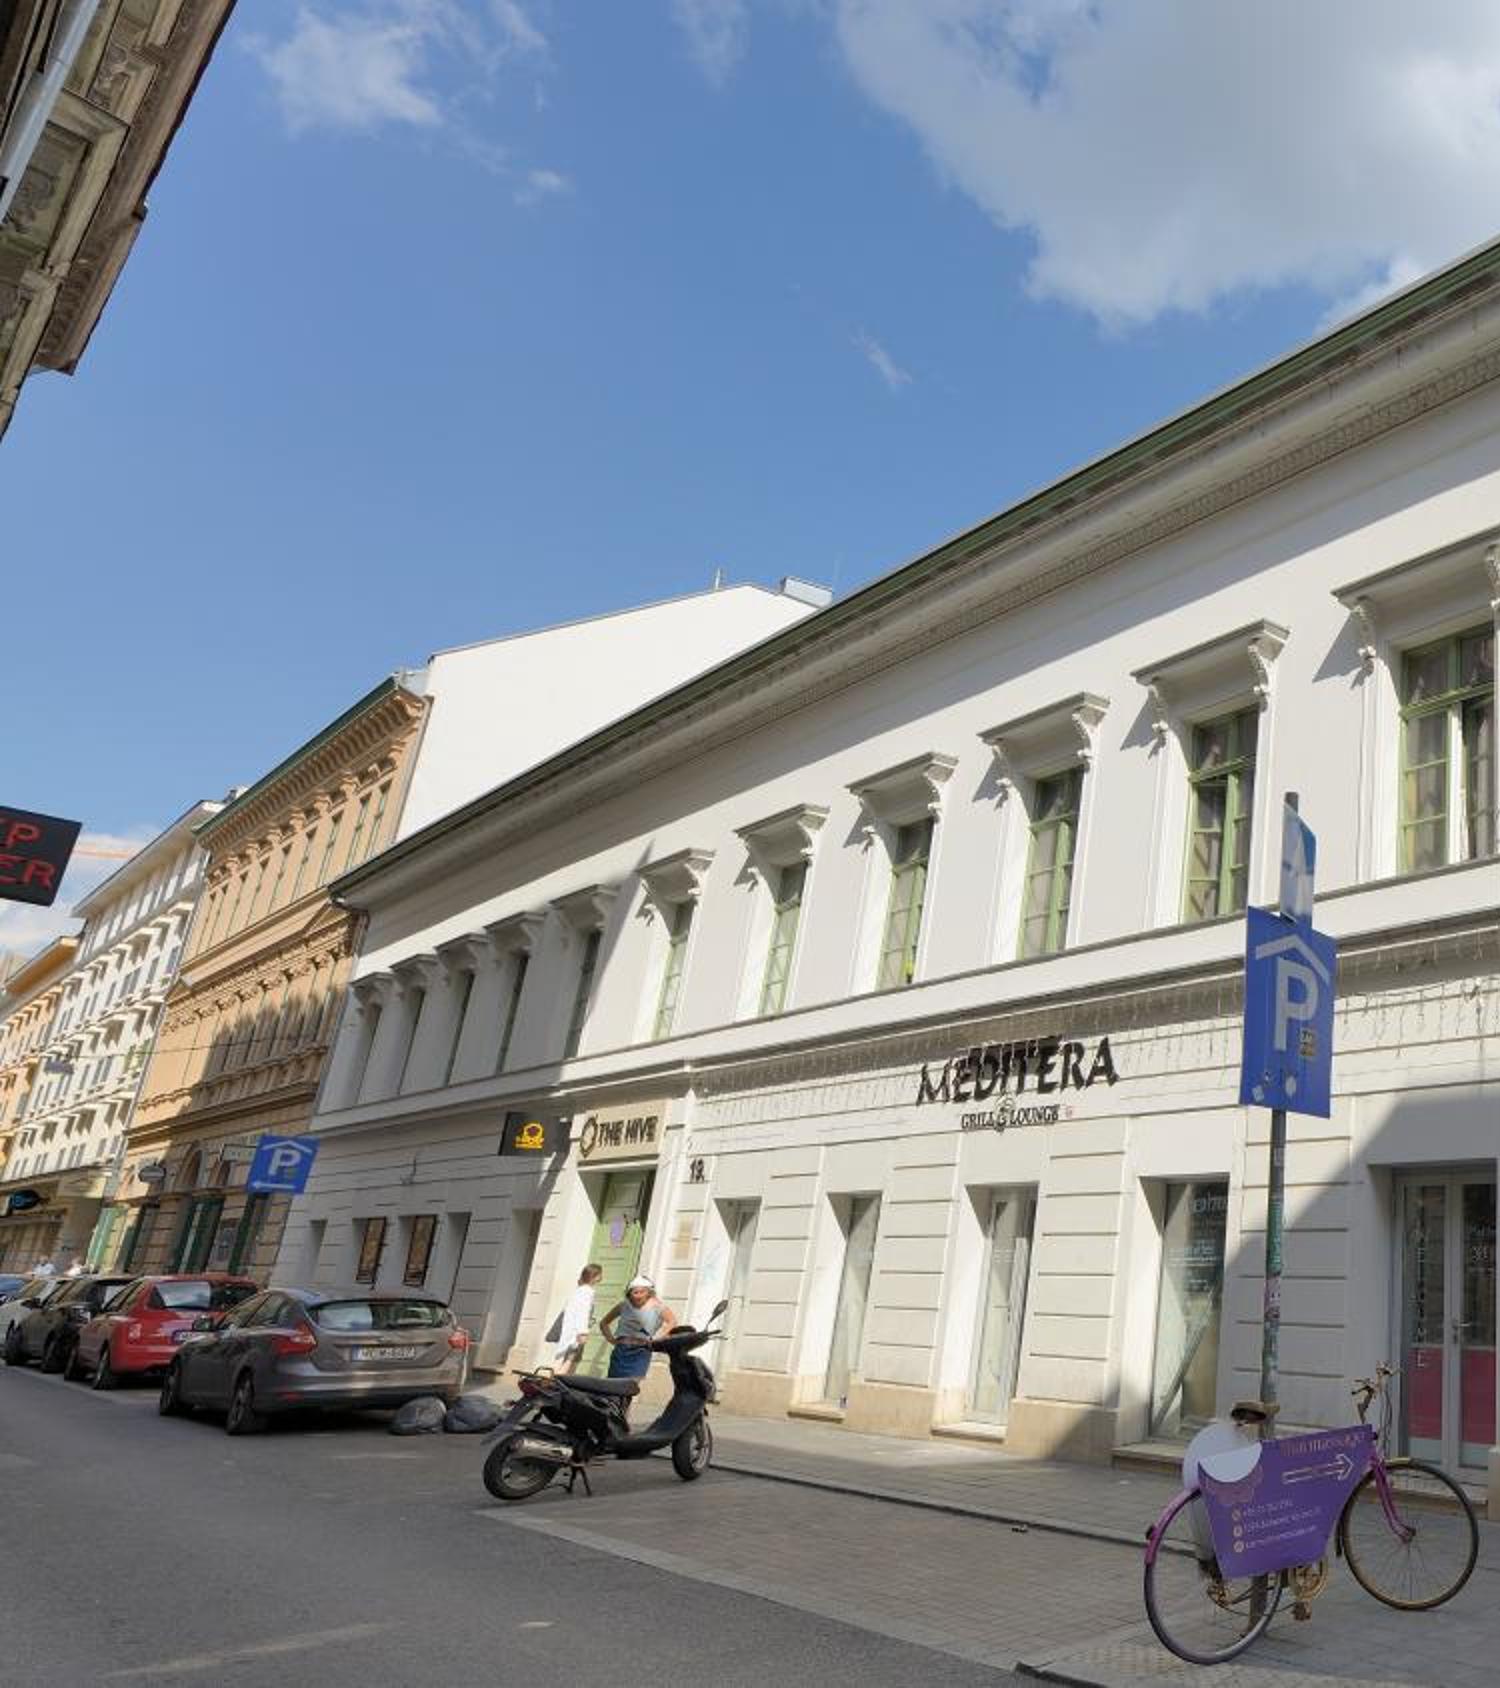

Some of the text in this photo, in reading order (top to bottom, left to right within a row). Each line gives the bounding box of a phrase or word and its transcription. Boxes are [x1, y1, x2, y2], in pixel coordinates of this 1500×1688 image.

[1274, 957, 1319, 1051] P
[915, 1034, 1120, 1107] MEDITERA
[598, 1115, 659, 1149] THE HIVE
[961, 1110, 994, 1130] GRILL
[1009, 1104, 1061, 1126] LOUNGE
[268, 1148, 301, 1177] P
